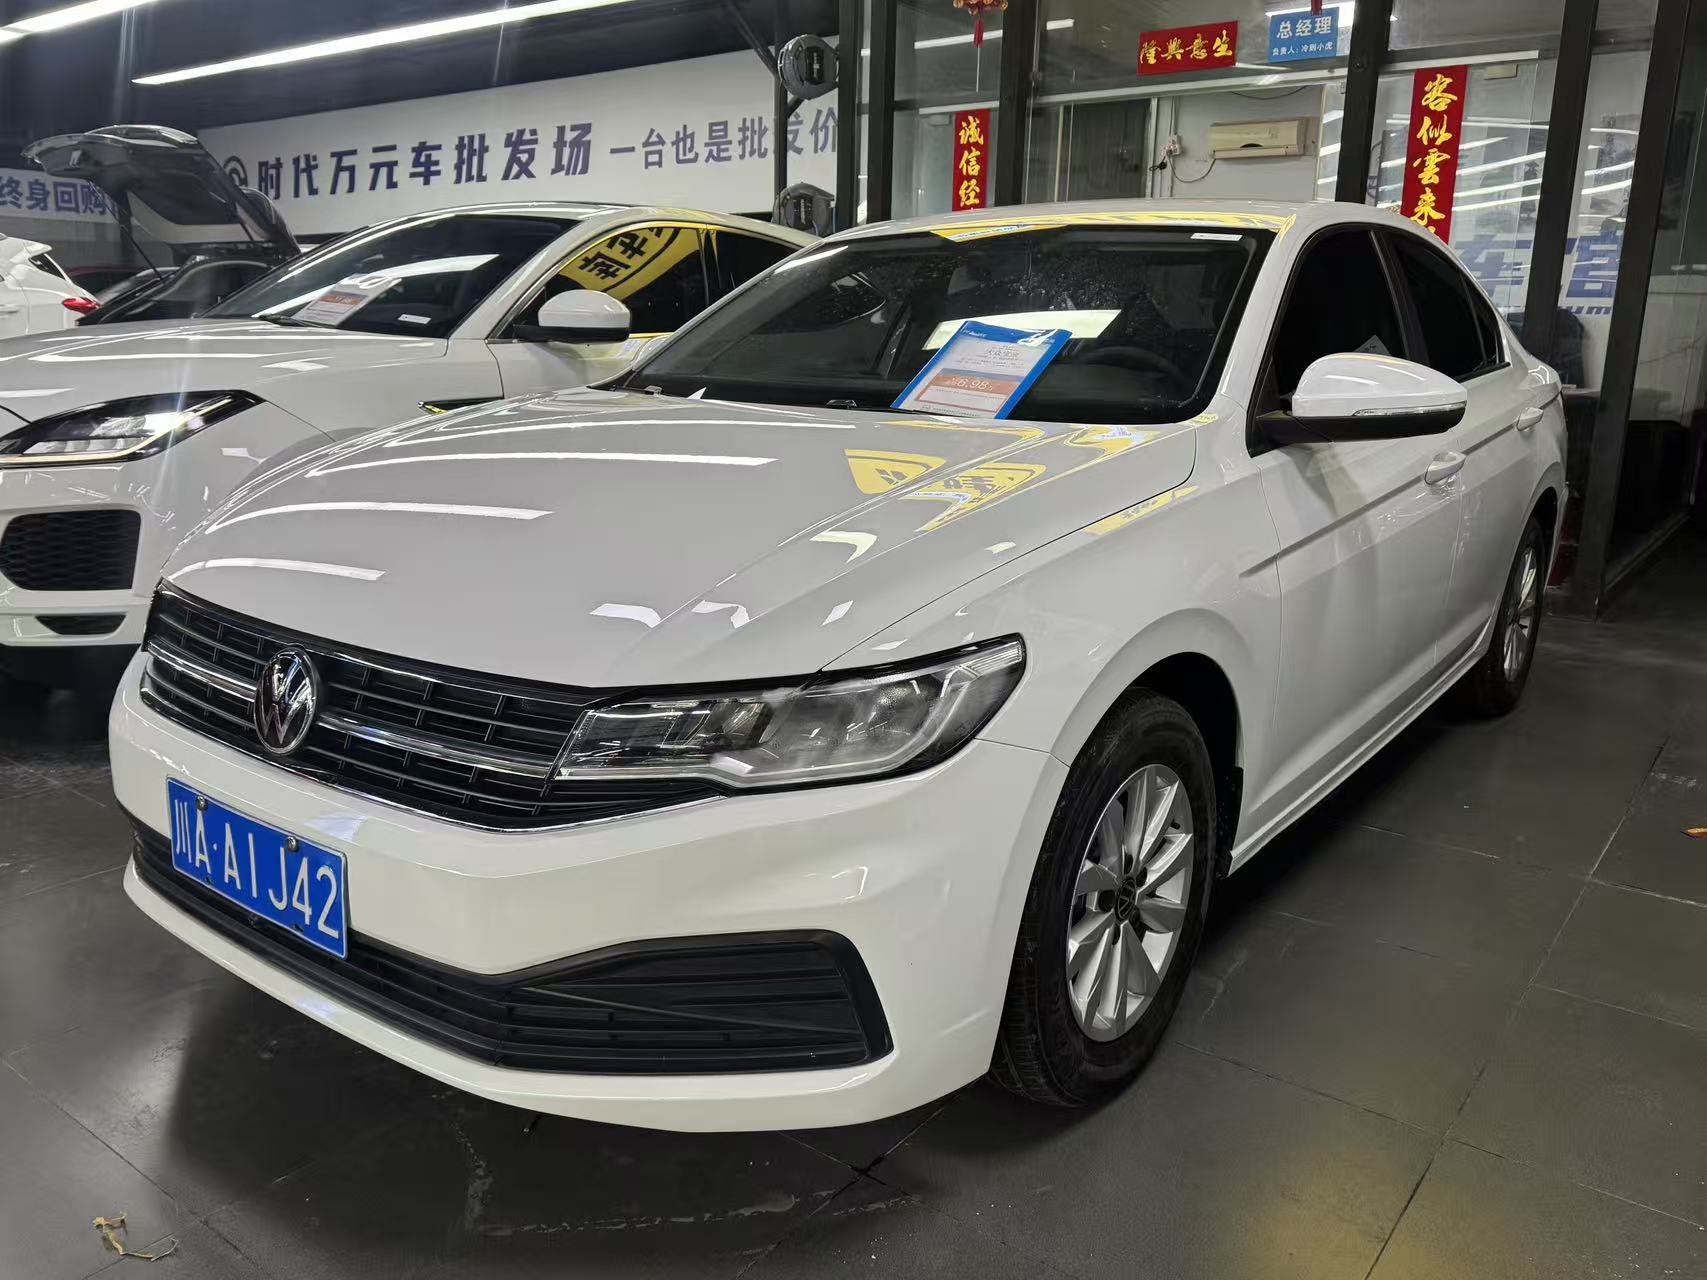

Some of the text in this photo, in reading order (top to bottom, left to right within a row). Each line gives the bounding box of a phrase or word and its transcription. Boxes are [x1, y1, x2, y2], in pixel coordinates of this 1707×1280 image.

[1277, 15, 1332, 39] 总经理
[257, 122, 593, 200] 时代万元车批发场
[609, 106, 839, 170] 一台也是批发价
[959, 115, 984, 210] 诚信经
